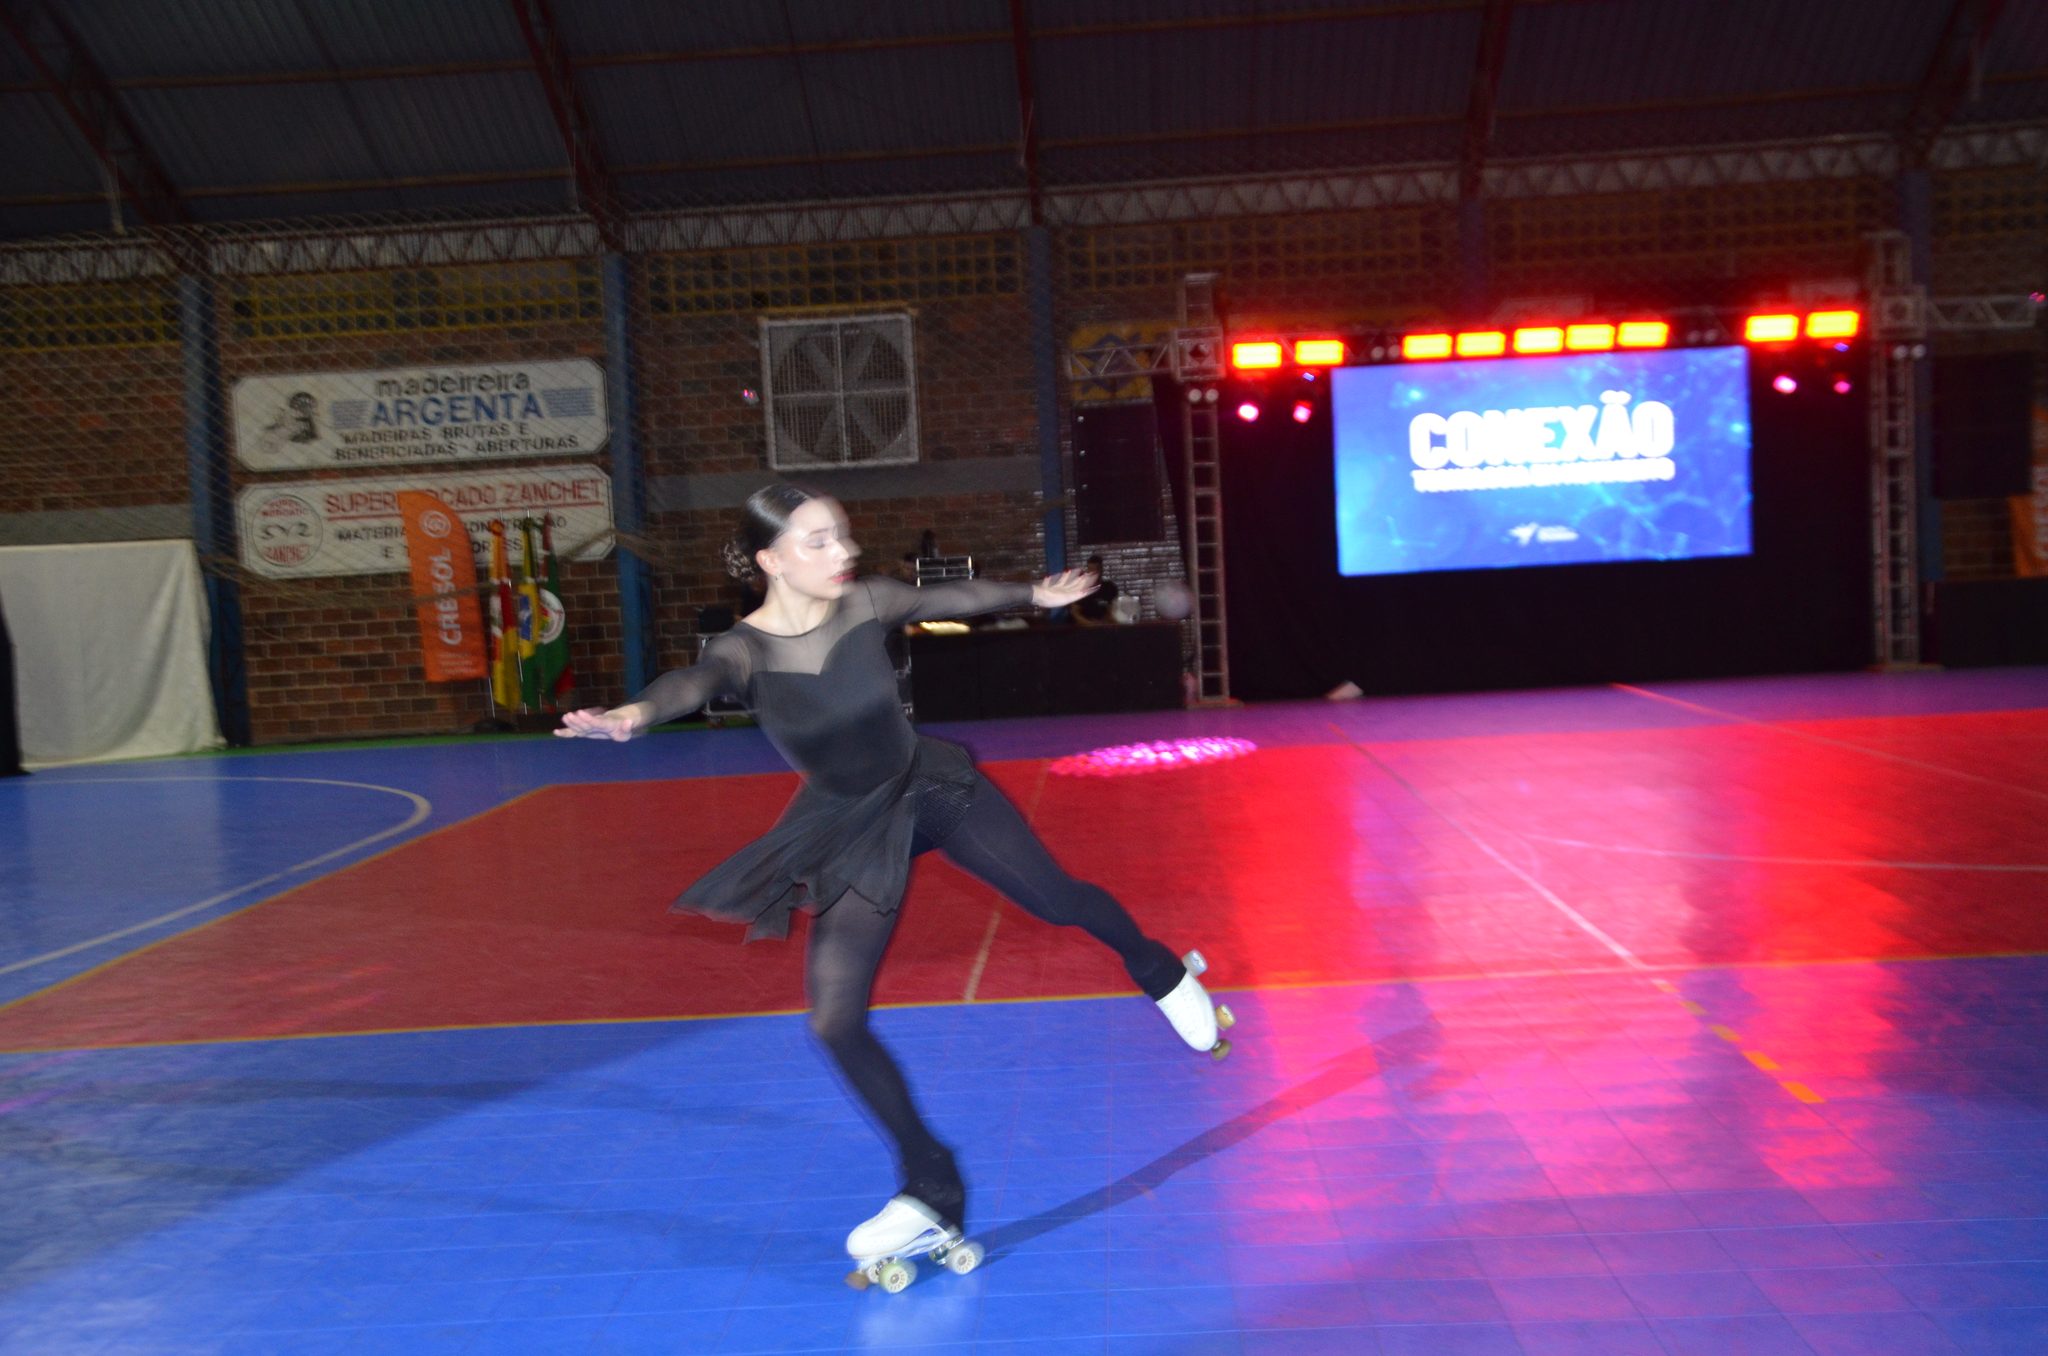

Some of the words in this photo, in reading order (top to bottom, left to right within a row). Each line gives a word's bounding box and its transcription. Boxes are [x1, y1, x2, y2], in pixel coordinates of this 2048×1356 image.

[376, 371, 531, 396] madeireira
[372, 392, 544, 426] ARGENTA
[342, 426, 432, 444] MADEIRAS
[442, 422, 511, 440] BRUTAS
[519, 422, 530, 435] E
[1409, 389, 1675, 469] CONEXÃO
[335, 440, 457, 460] BENEFICIADAS
[475, 434, 580, 453] ABERTURAS
[326, 484, 498, 513] SUPERCADO
[429, 546, 463, 646] CRESOL
